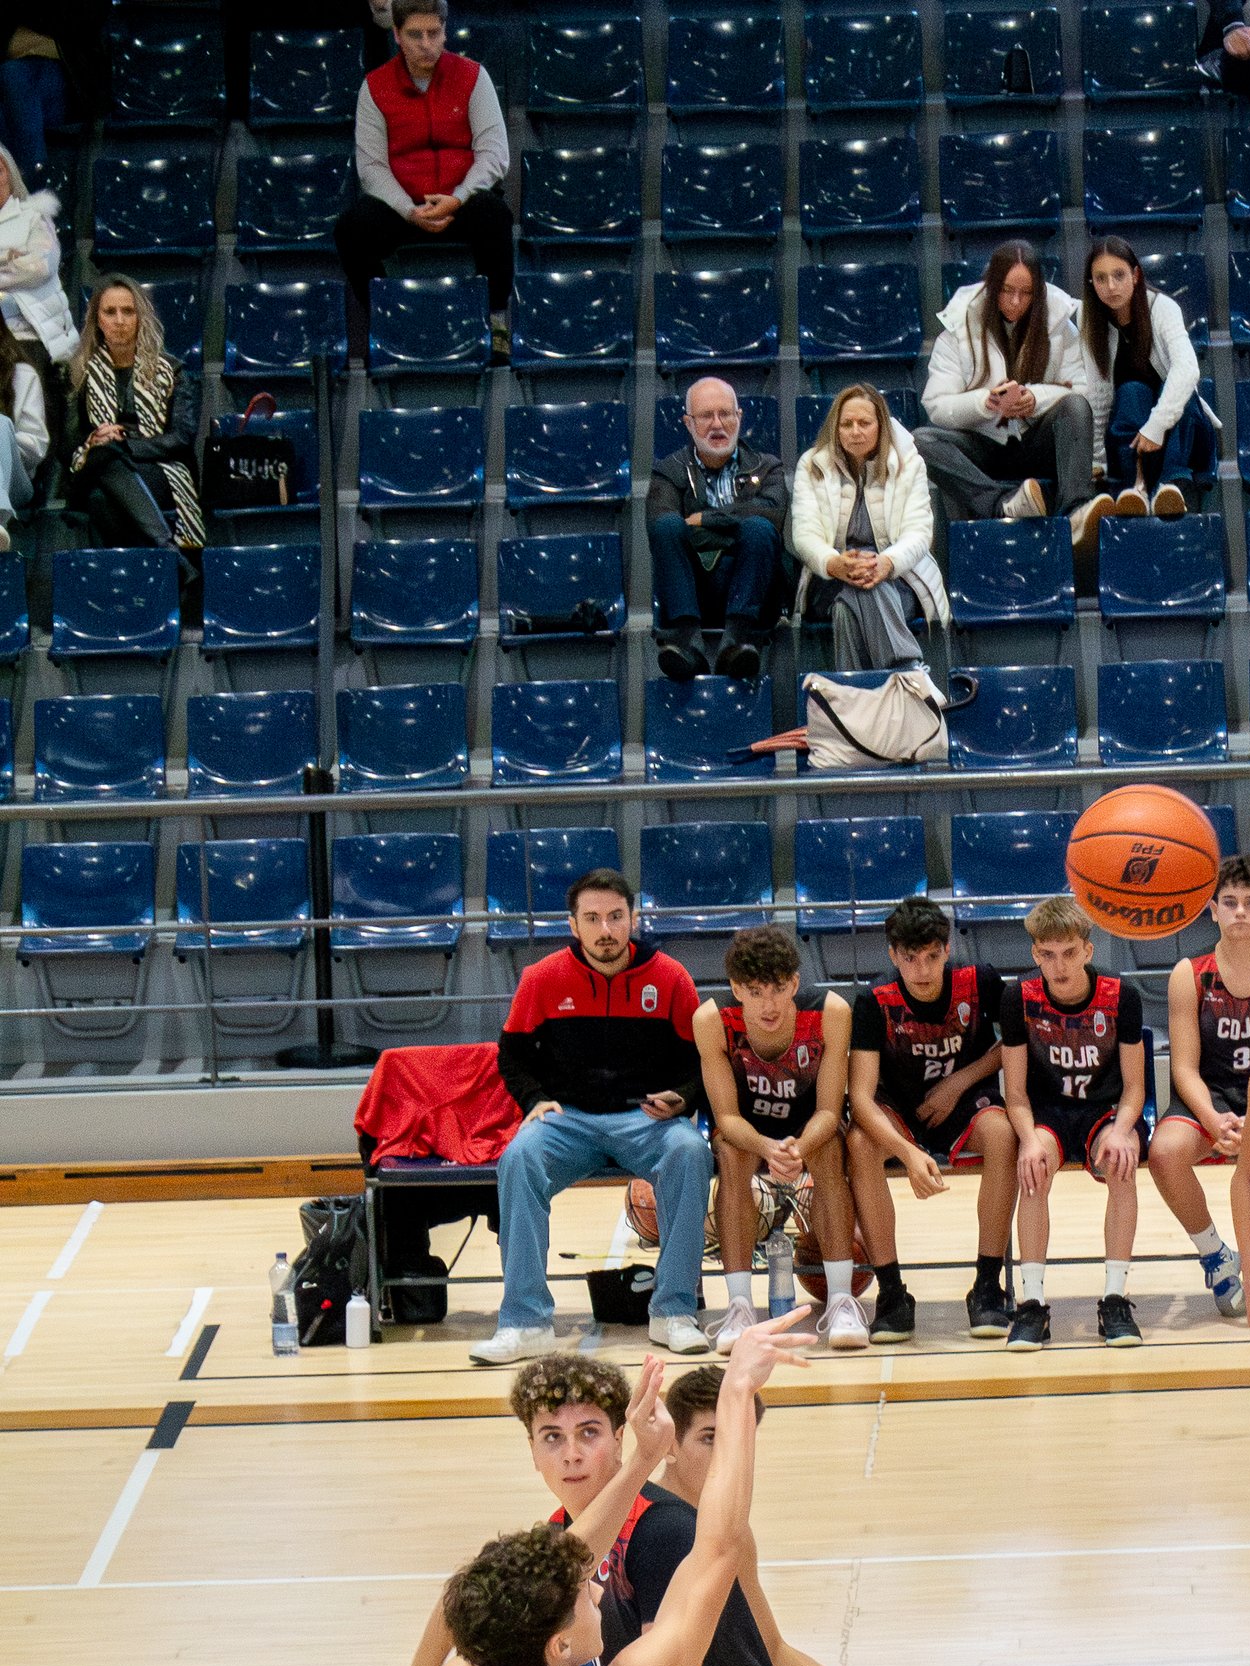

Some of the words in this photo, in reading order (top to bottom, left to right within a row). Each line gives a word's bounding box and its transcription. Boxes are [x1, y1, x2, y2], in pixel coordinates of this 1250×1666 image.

[911, 1035, 963, 1057] CDJR
[1049, 1045, 1100, 1068] CDJR
[923, 1058, 956, 1081] 21
[1233, 1046, 1250, 1070] 3
[746, 1075, 797, 1099] CDJR
[1061, 1074, 1093, 1099] 17
[752, 1098, 791, 1119] 99
